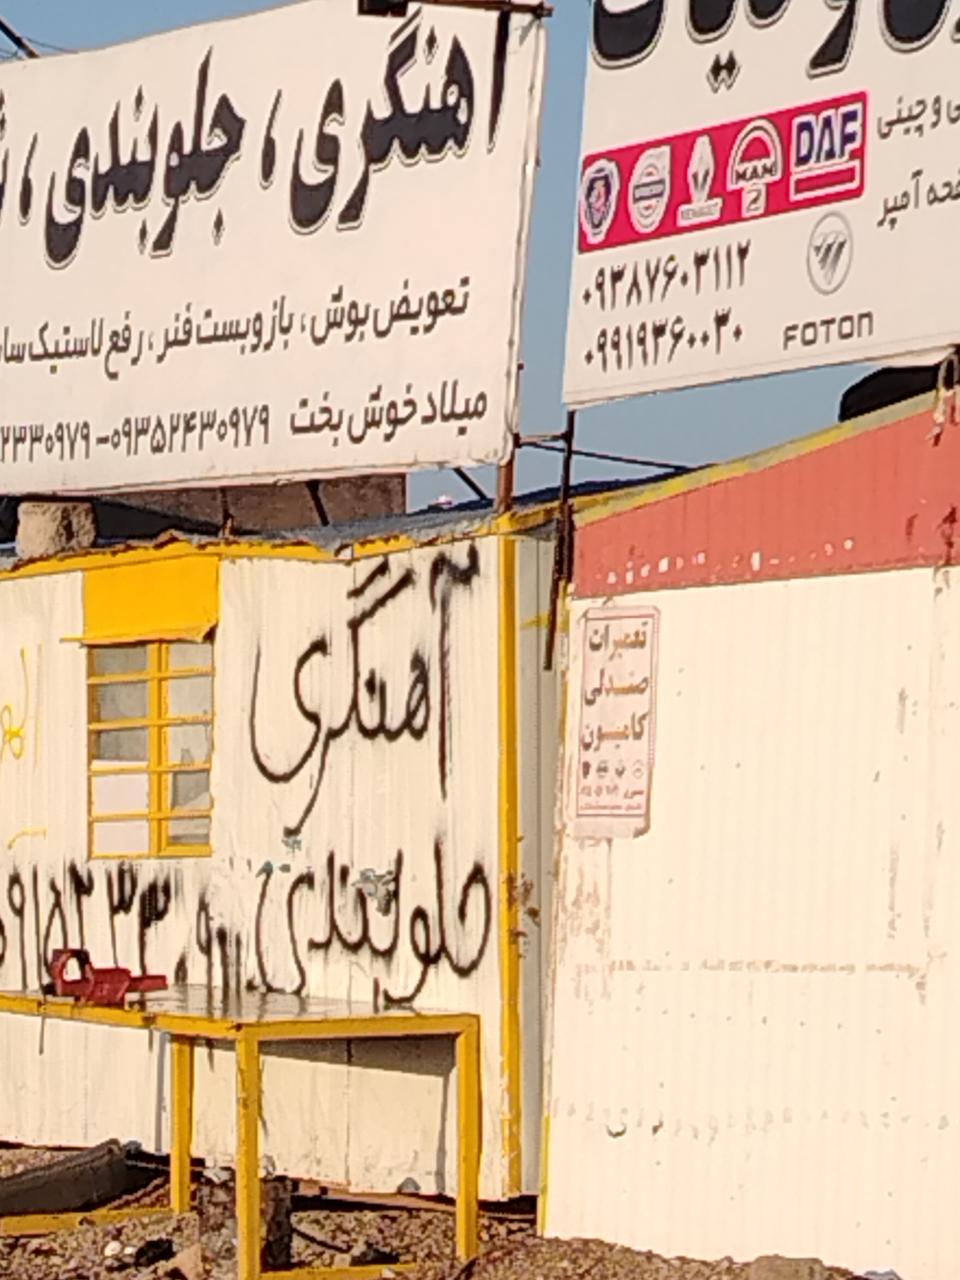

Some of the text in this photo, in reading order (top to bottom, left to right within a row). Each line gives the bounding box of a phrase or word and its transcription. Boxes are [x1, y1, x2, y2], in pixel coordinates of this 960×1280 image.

[794, 108, 860, 168] DAF
[736, 161, 778, 185] MAN
[373, 275, 470, 338] تعویض
[28, 318, 104, 375] لاستیک
[104, 310, 144, 380] رفع
[421, 379, 488, 436] میلاد
[250, 542, 480, 838] آهنگری
